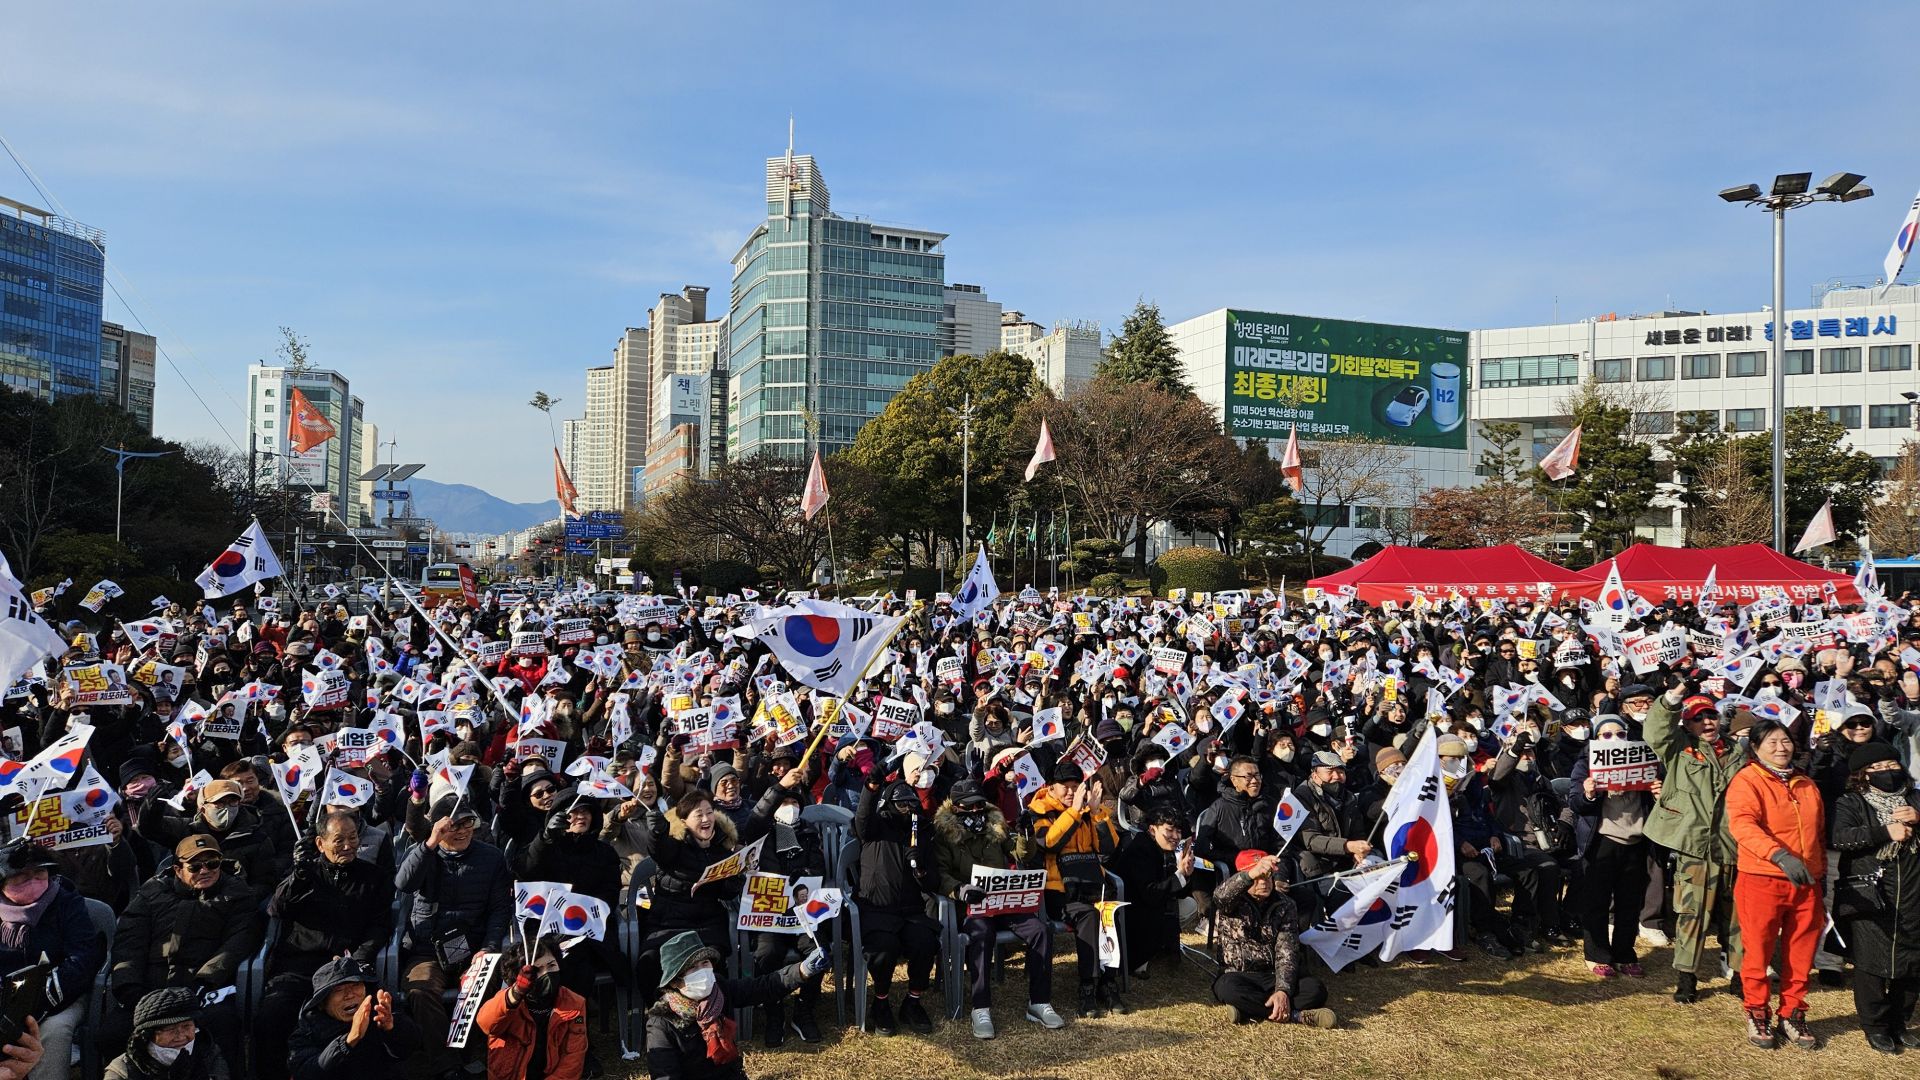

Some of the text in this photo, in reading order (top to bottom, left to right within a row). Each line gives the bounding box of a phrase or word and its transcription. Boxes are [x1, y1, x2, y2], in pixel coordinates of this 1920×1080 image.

[1645, 328, 1701, 346] 새로운
[1706, 325, 1752, 343] 미래!
[1234, 346, 1420, 380] 미래모빌리티 기회발전특구
[1233, 371, 1328, 403] 최종지정!
[1436, 389, 1455, 403] H2
[1232, 405, 1314, 420] 미래 50년 혁신성장 이끌
[1232, 418, 1349, 434] 수소기반 모빌리티 산업 중심지 도약
[1791, 586, 1820, 599] 연합
[1634, 636, 1681, 655] MBC 사장
[1642, 648, 1681, 666] 사퇴하라!
[70, 665, 100, 680] 내란
[78, 678, 109, 692] 수괴
[100, 689, 130, 699] 체포하라
[681, 712, 709, 731] 계엄
[880, 704, 916, 722] 계엄
[832, 726, 852, 734] 체포하
[750, 877, 785, 896] 내란
[974, 872, 1044, 893] 계엄합법
[753, 896, 790, 914] 수괴
[740, 915, 774, 927] 이재명
